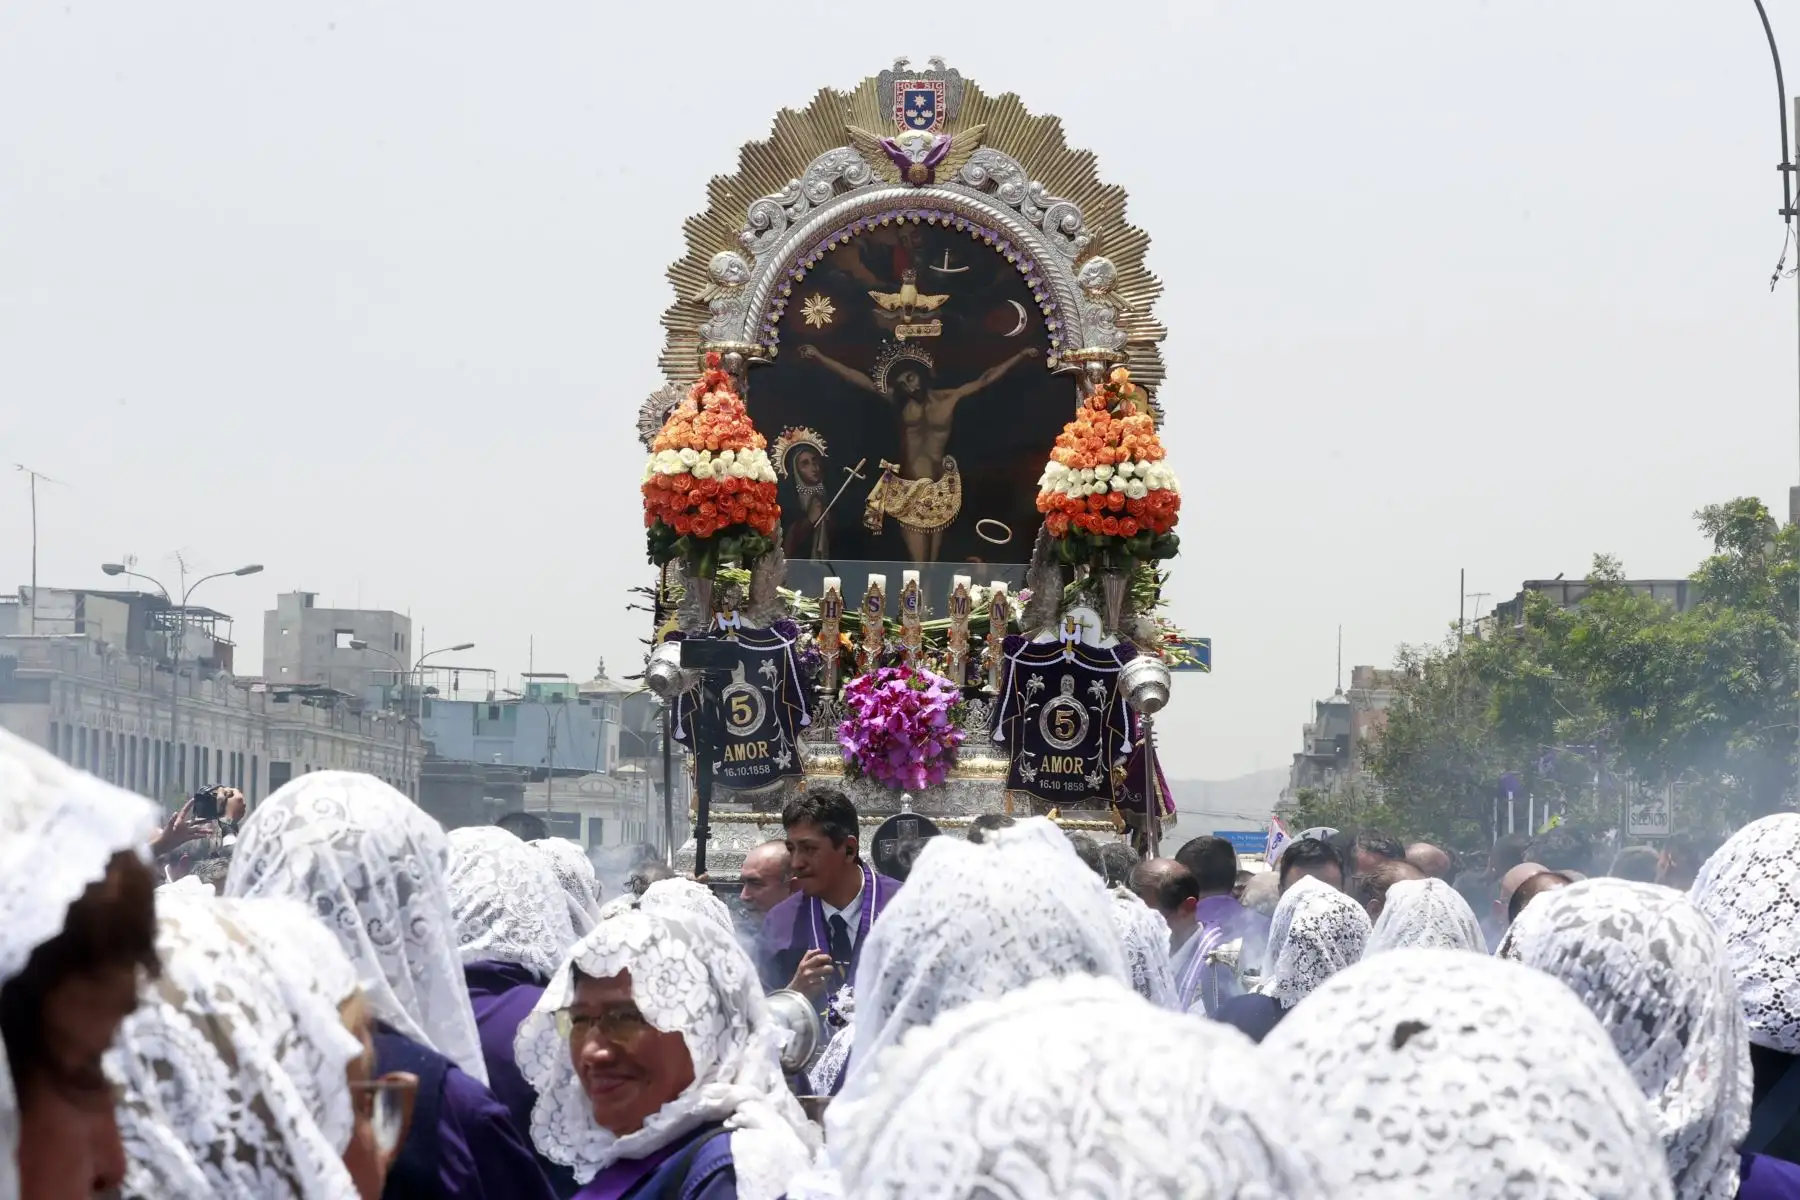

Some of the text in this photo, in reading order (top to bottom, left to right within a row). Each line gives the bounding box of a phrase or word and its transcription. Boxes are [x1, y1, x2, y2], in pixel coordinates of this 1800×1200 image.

[824, 601, 837, 618] H
[868, 596, 880, 612] S
[955, 597, 967, 615] M
[994, 603, 1006, 620] N
[731, 694, 752, 725] 5
[1055, 709, 1075, 739] 5
[723, 740, 770, 763] AMOR
[723, 764, 771, 777] 16.10.1858
[1040, 755, 1085, 775] AMOR
